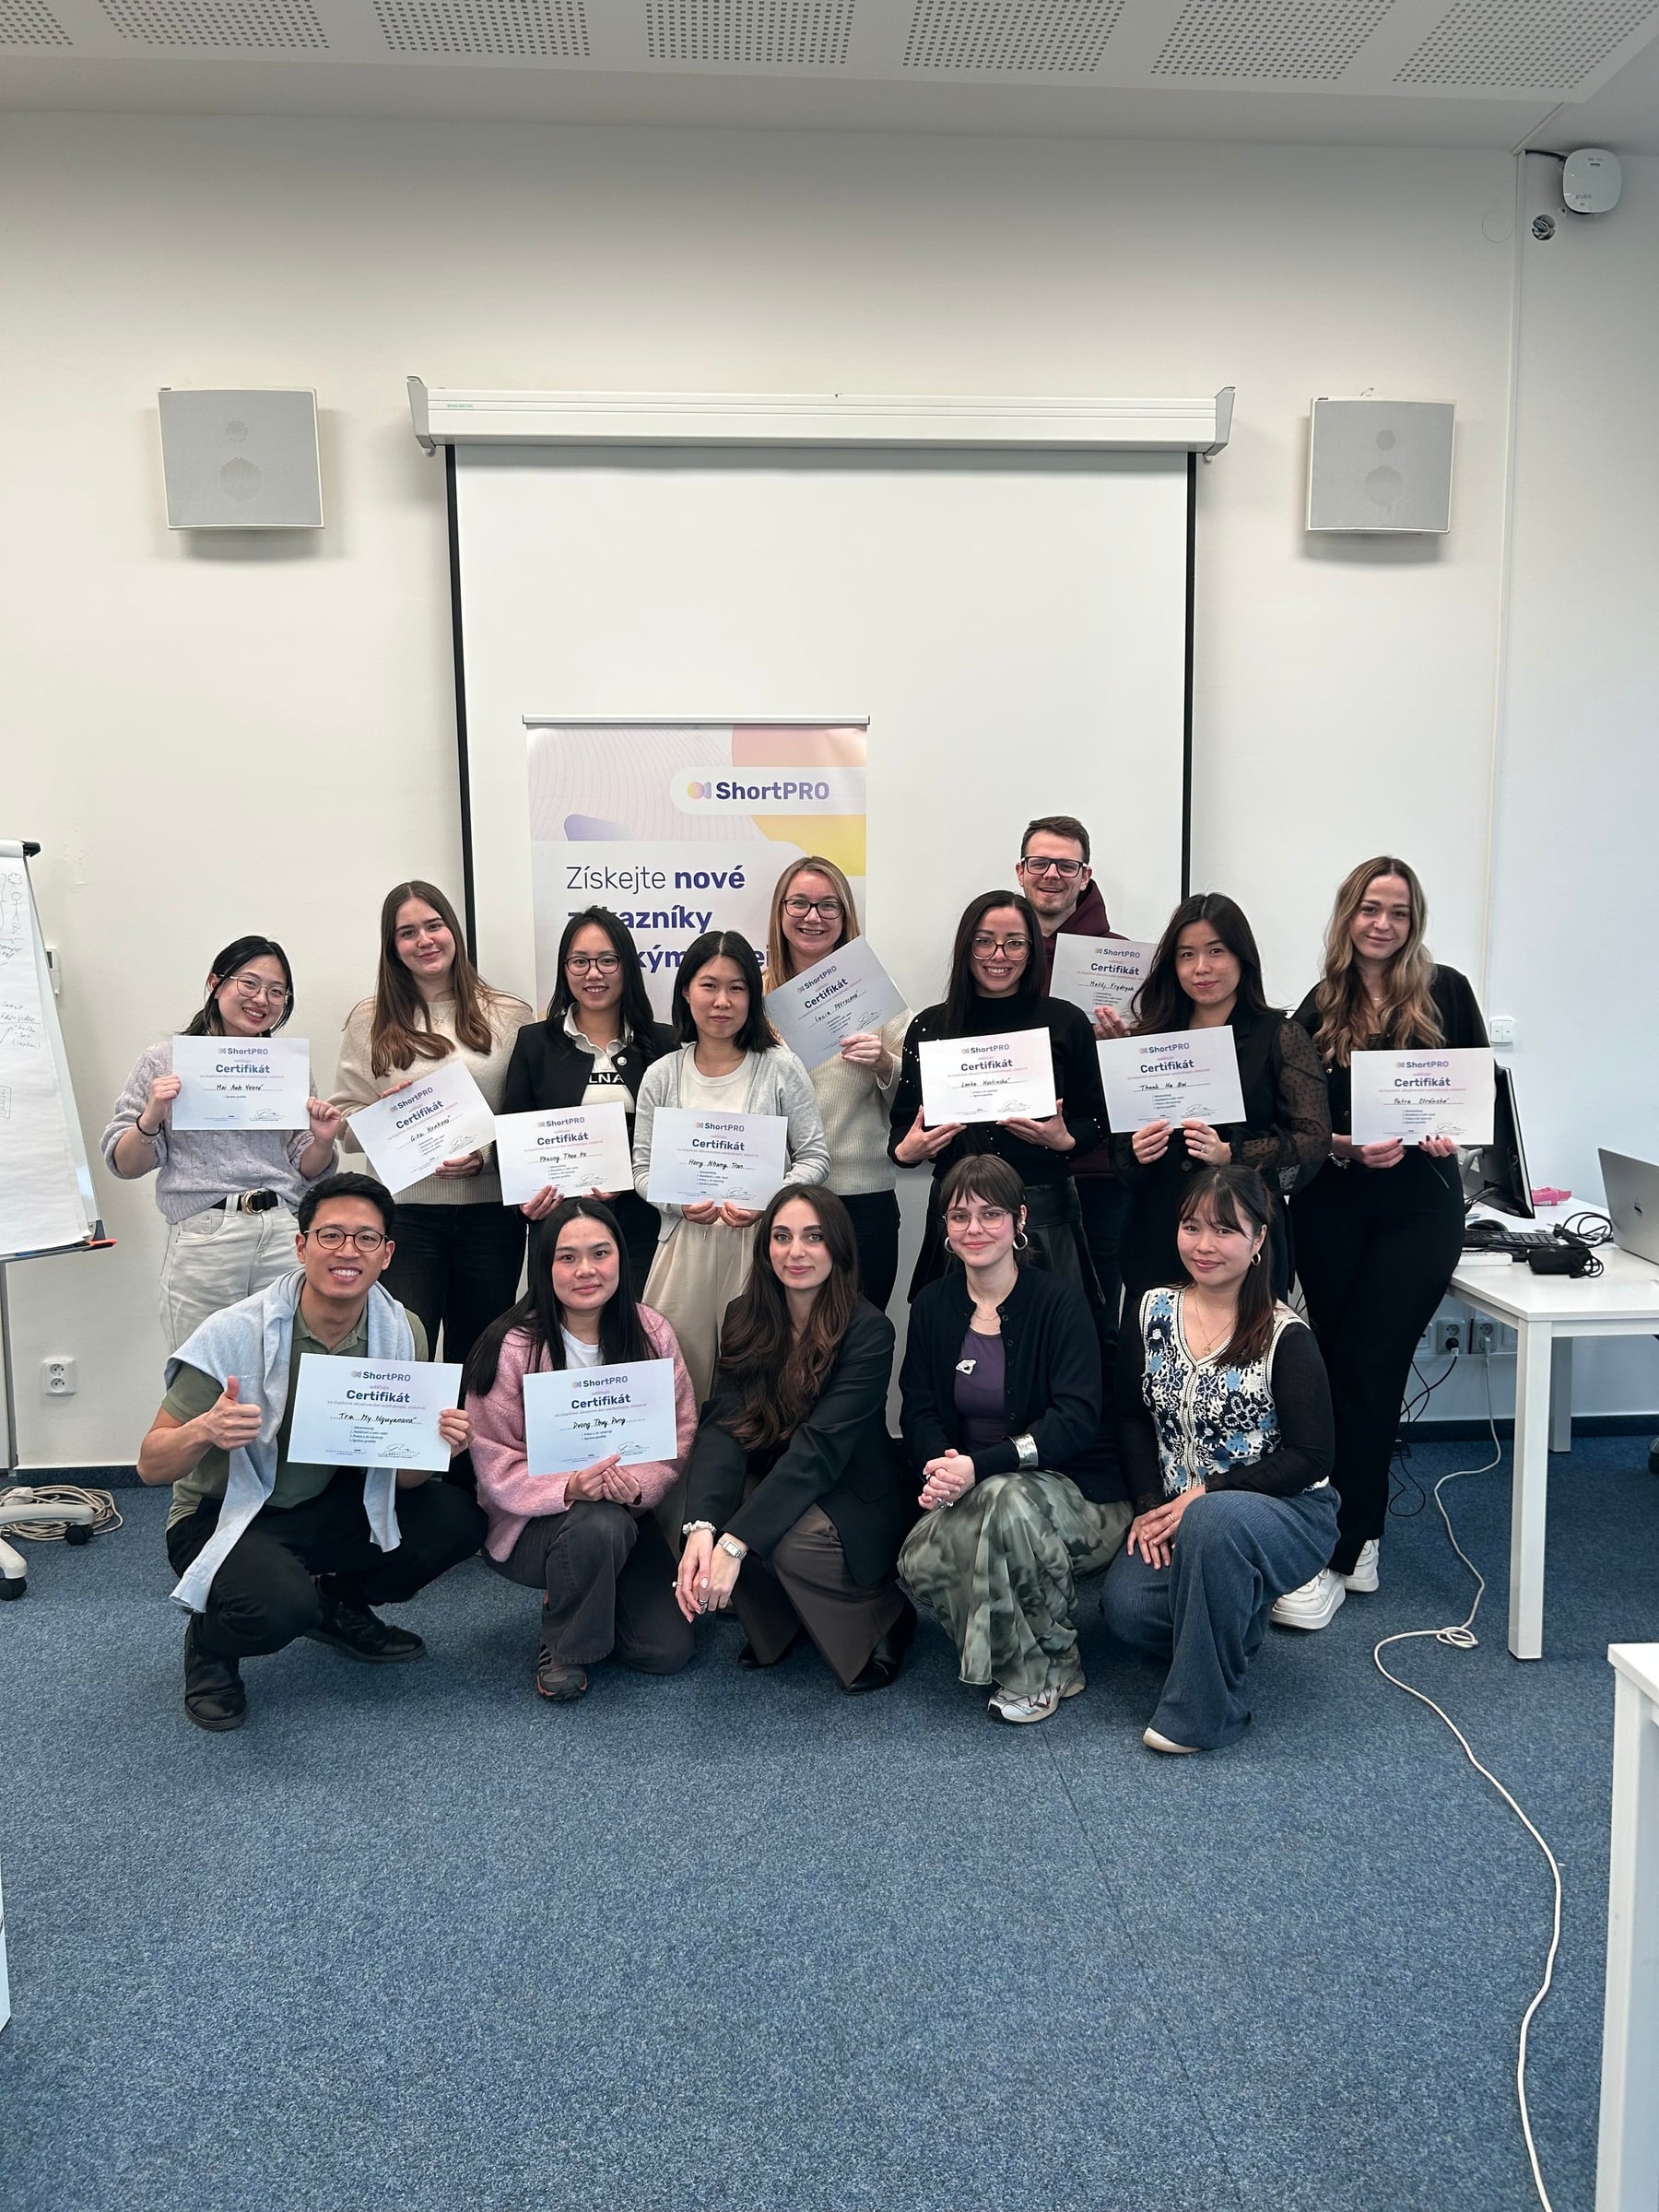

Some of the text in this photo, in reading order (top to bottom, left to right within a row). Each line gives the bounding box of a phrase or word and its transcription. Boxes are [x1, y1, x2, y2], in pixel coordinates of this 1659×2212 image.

[715, 781, 830, 800] ShortPRO
[566, 865, 746, 894] Získejte nové
[568, 905, 713, 934] azníky
[1103, 948, 1141, 959] ShortPRO
[1090, 962, 1140, 976] Certifikát
[804, 965, 838, 990] ShortPRO
[804, 978, 849, 1009] Certifikát
[228, 1047, 269, 1055] ShortPRO
[971, 1043, 1010, 1054] ShortPRO
[1148, 1042, 1190, 1053] ShortPRO
[216, 1064, 270, 1074] Certifikát
[960, 1059, 1014, 1072] Certifikát
[1140, 1059, 1194, 1074] Certifikát
[1406, 1060, 1450, 1068] ShortPRO
[1394, 1077, 1451, 1088] Certifikát
[397, 1087, 434, 1110] ShortPRO
[395, 1100, 444, 1129] Certifikát
[546, 1117, 585, 1127] ShortPRO
[704, 1122, 745, 1133] ShortPRO
[537, 1132, 589, 1146] Certifikát
[692, 1138, 746, 1151] Certifikát
[362, 1371, 411, 1382] ShortPRO
[582, 1376, 629, 1388] ShortPRO
[347, 1390, 411, 1403] Certifikát
[571, 1394, 631, 1409] Certifikát
